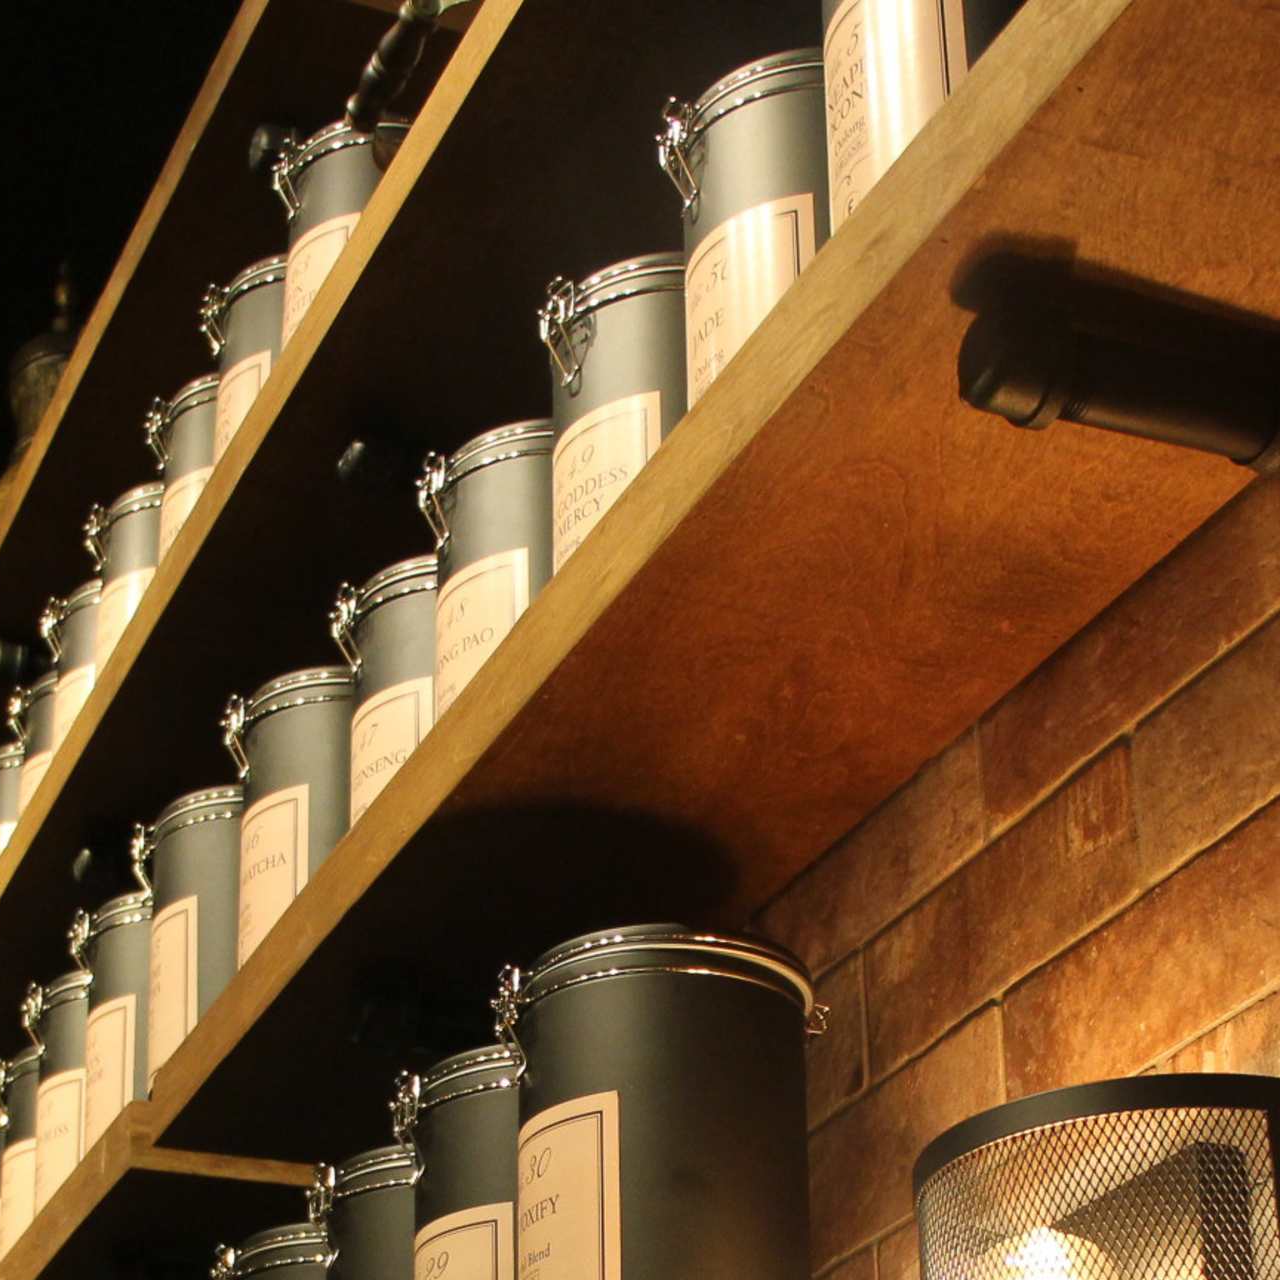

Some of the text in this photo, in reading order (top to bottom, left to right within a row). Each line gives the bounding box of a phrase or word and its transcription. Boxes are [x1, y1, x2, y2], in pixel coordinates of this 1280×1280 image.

[463, 626, 495, 653] PAO
[526, 1147, 553, 1185] 30
[528, 1242, 552, 1268] Blend
